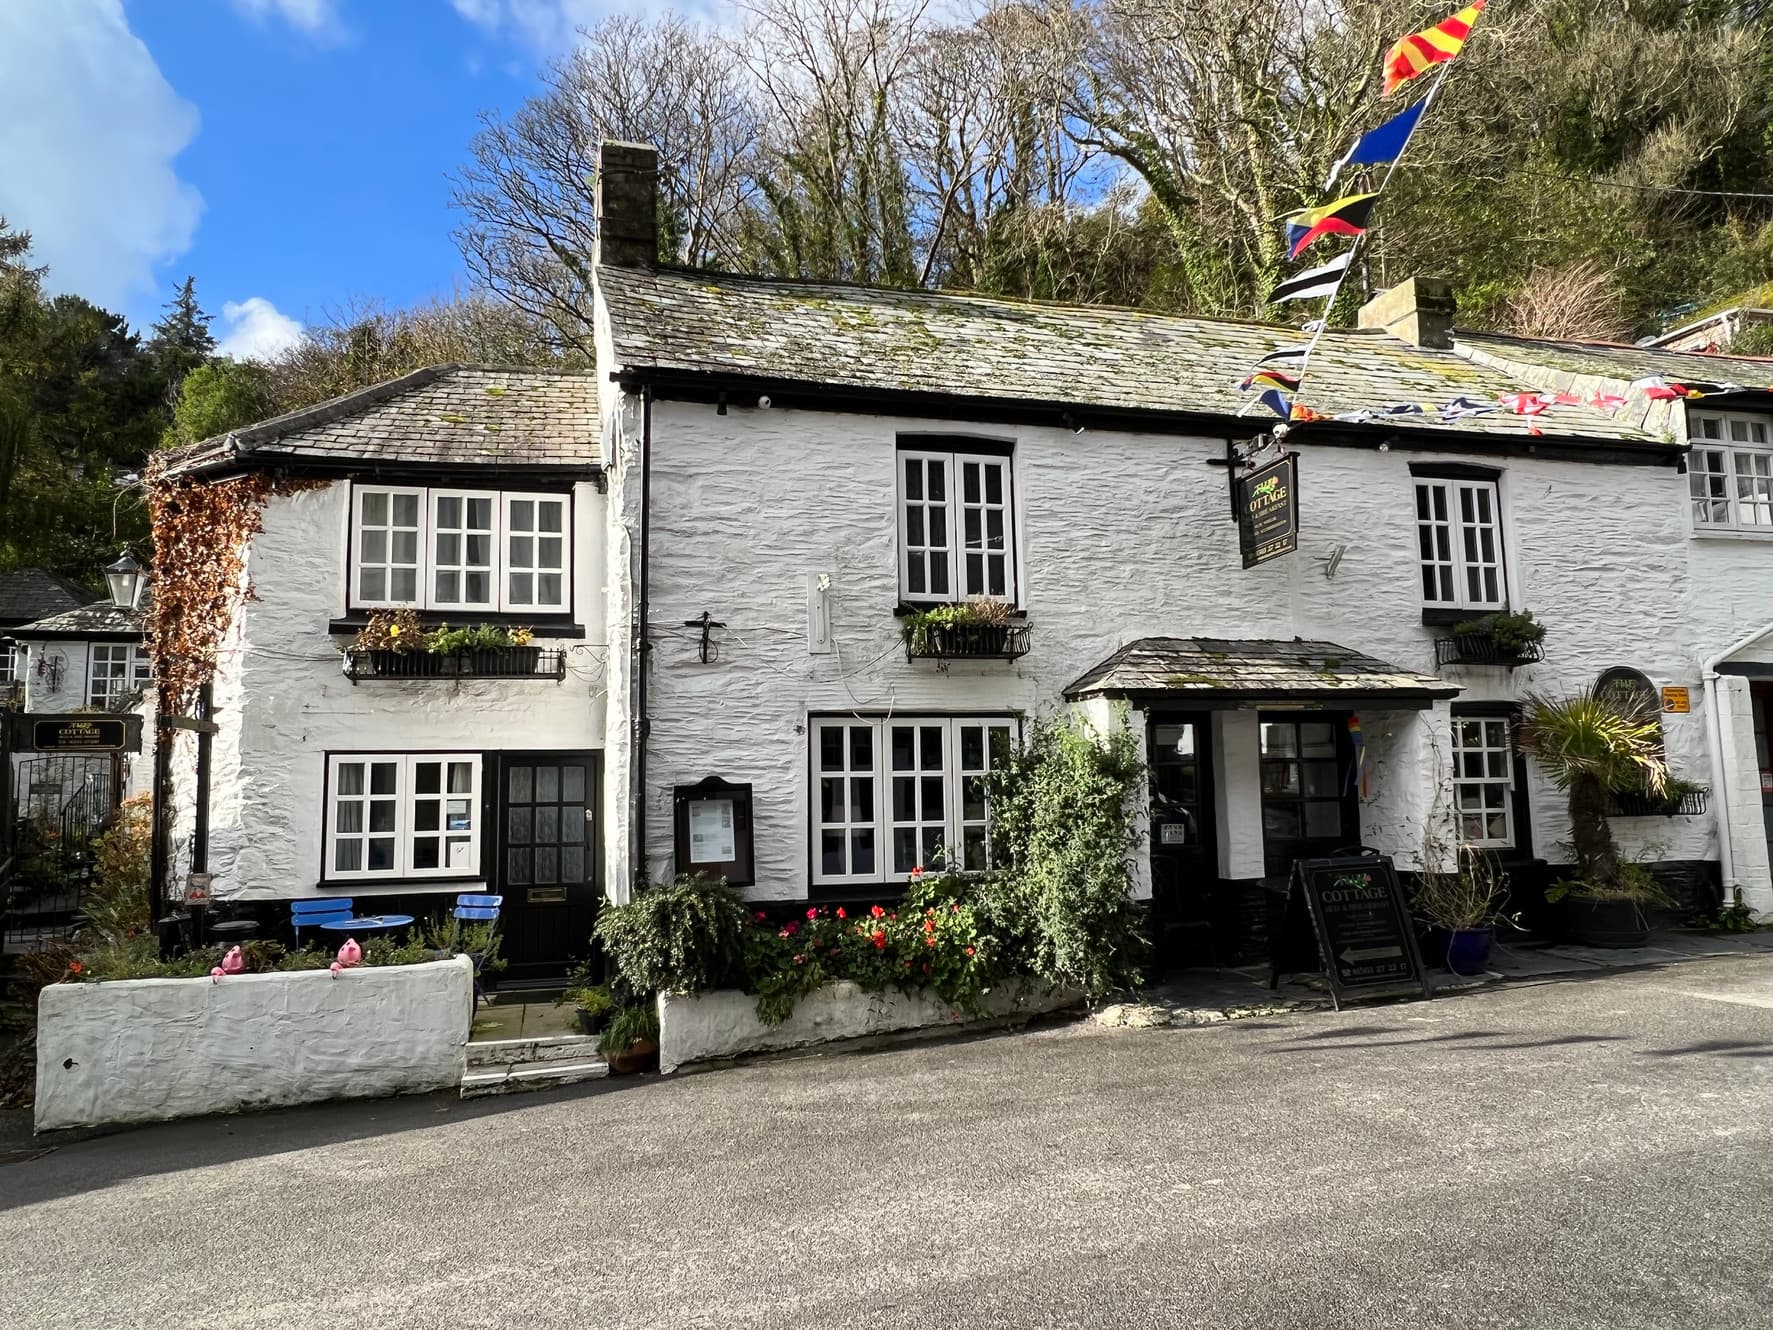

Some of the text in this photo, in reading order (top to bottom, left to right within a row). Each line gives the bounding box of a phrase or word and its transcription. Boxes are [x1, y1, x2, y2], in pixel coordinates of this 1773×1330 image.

[1249, 486, 1288, 513] OTTAGE
[1600, 687, 1649, 700] COTTGE
[1321, 886, 1389, 904] COTTAGE
